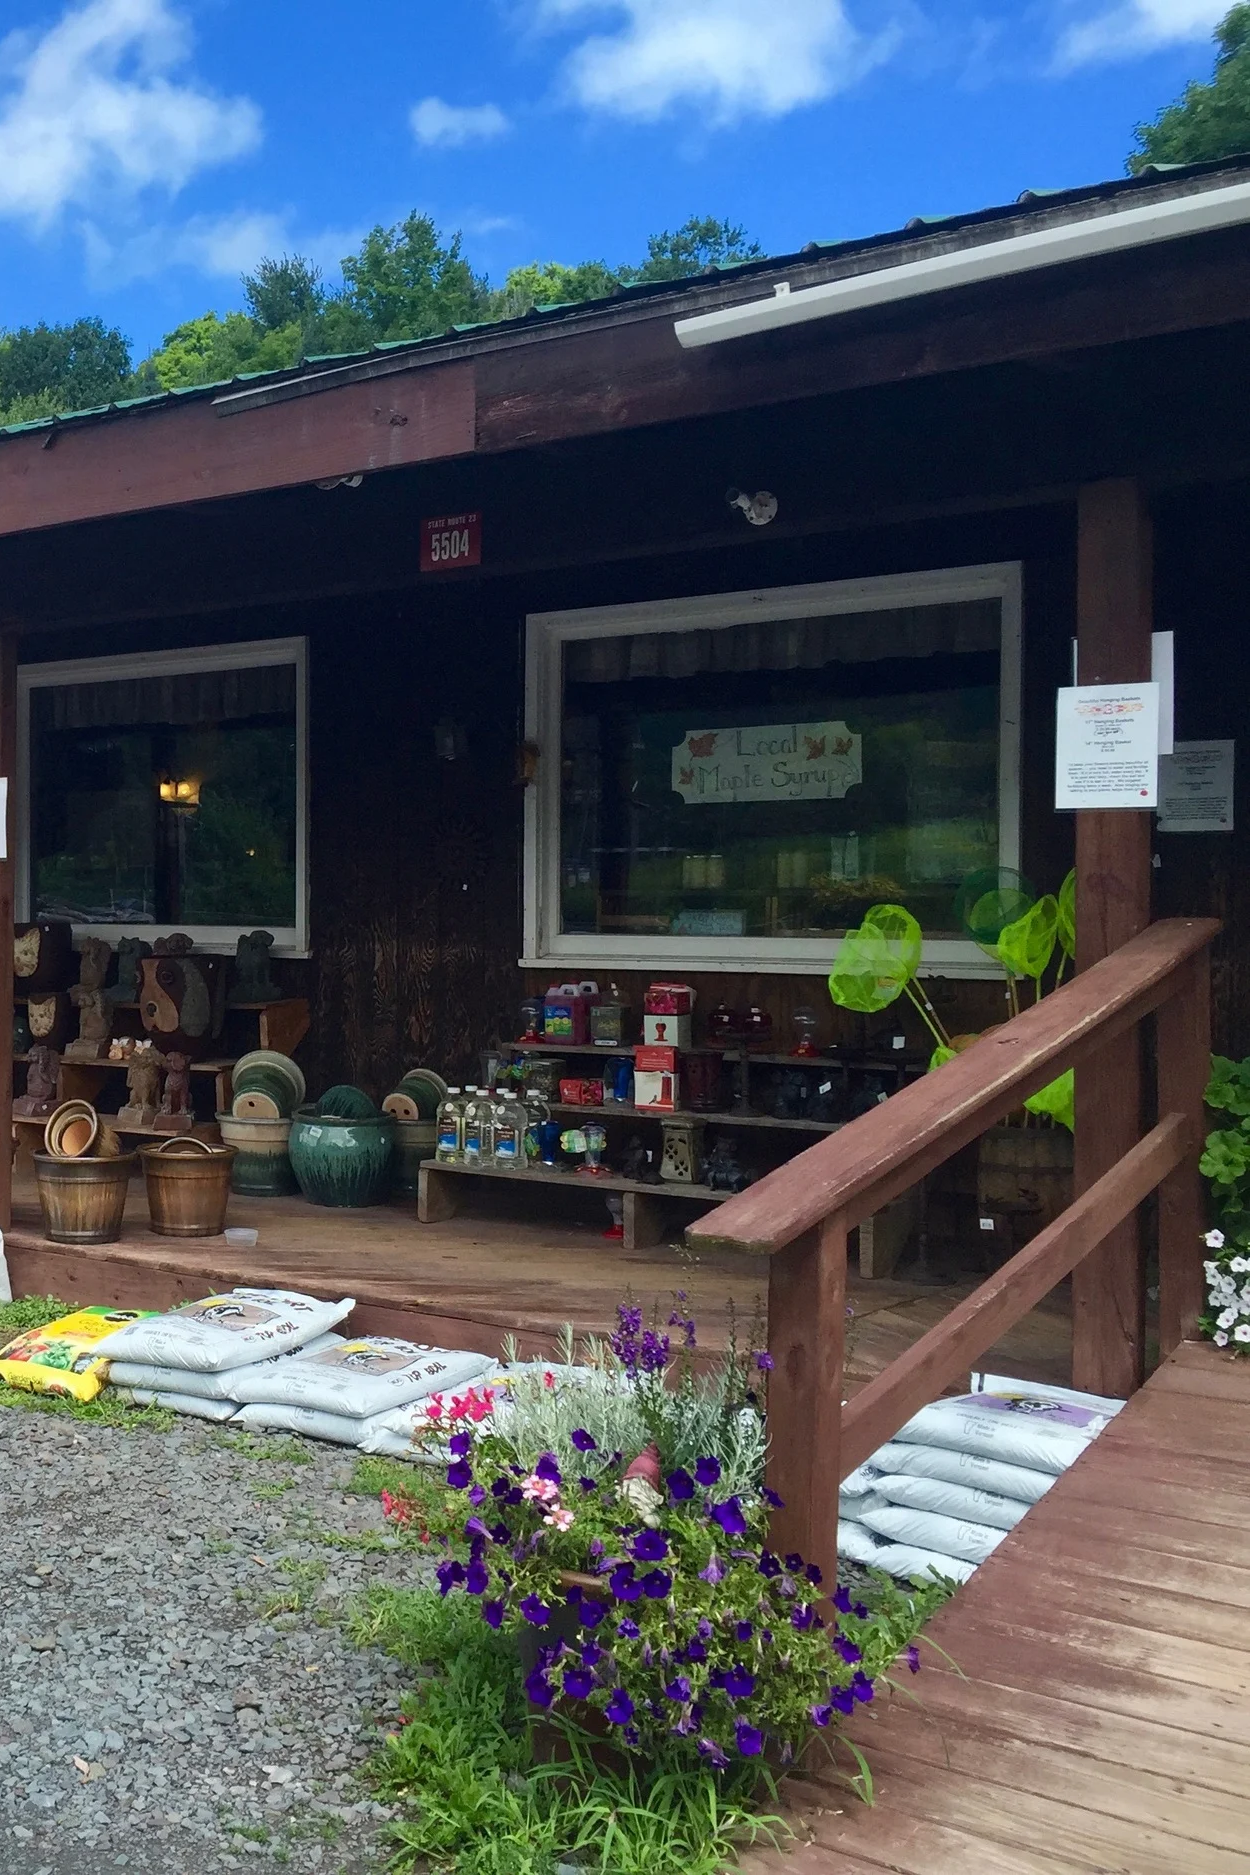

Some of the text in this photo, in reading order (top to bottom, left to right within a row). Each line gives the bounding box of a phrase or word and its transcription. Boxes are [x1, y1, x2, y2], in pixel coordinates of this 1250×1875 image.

[431, 529, 469, 562] 5504
[736, 726, 798, 757] Local
[698, 764, 764, 800] Maple
